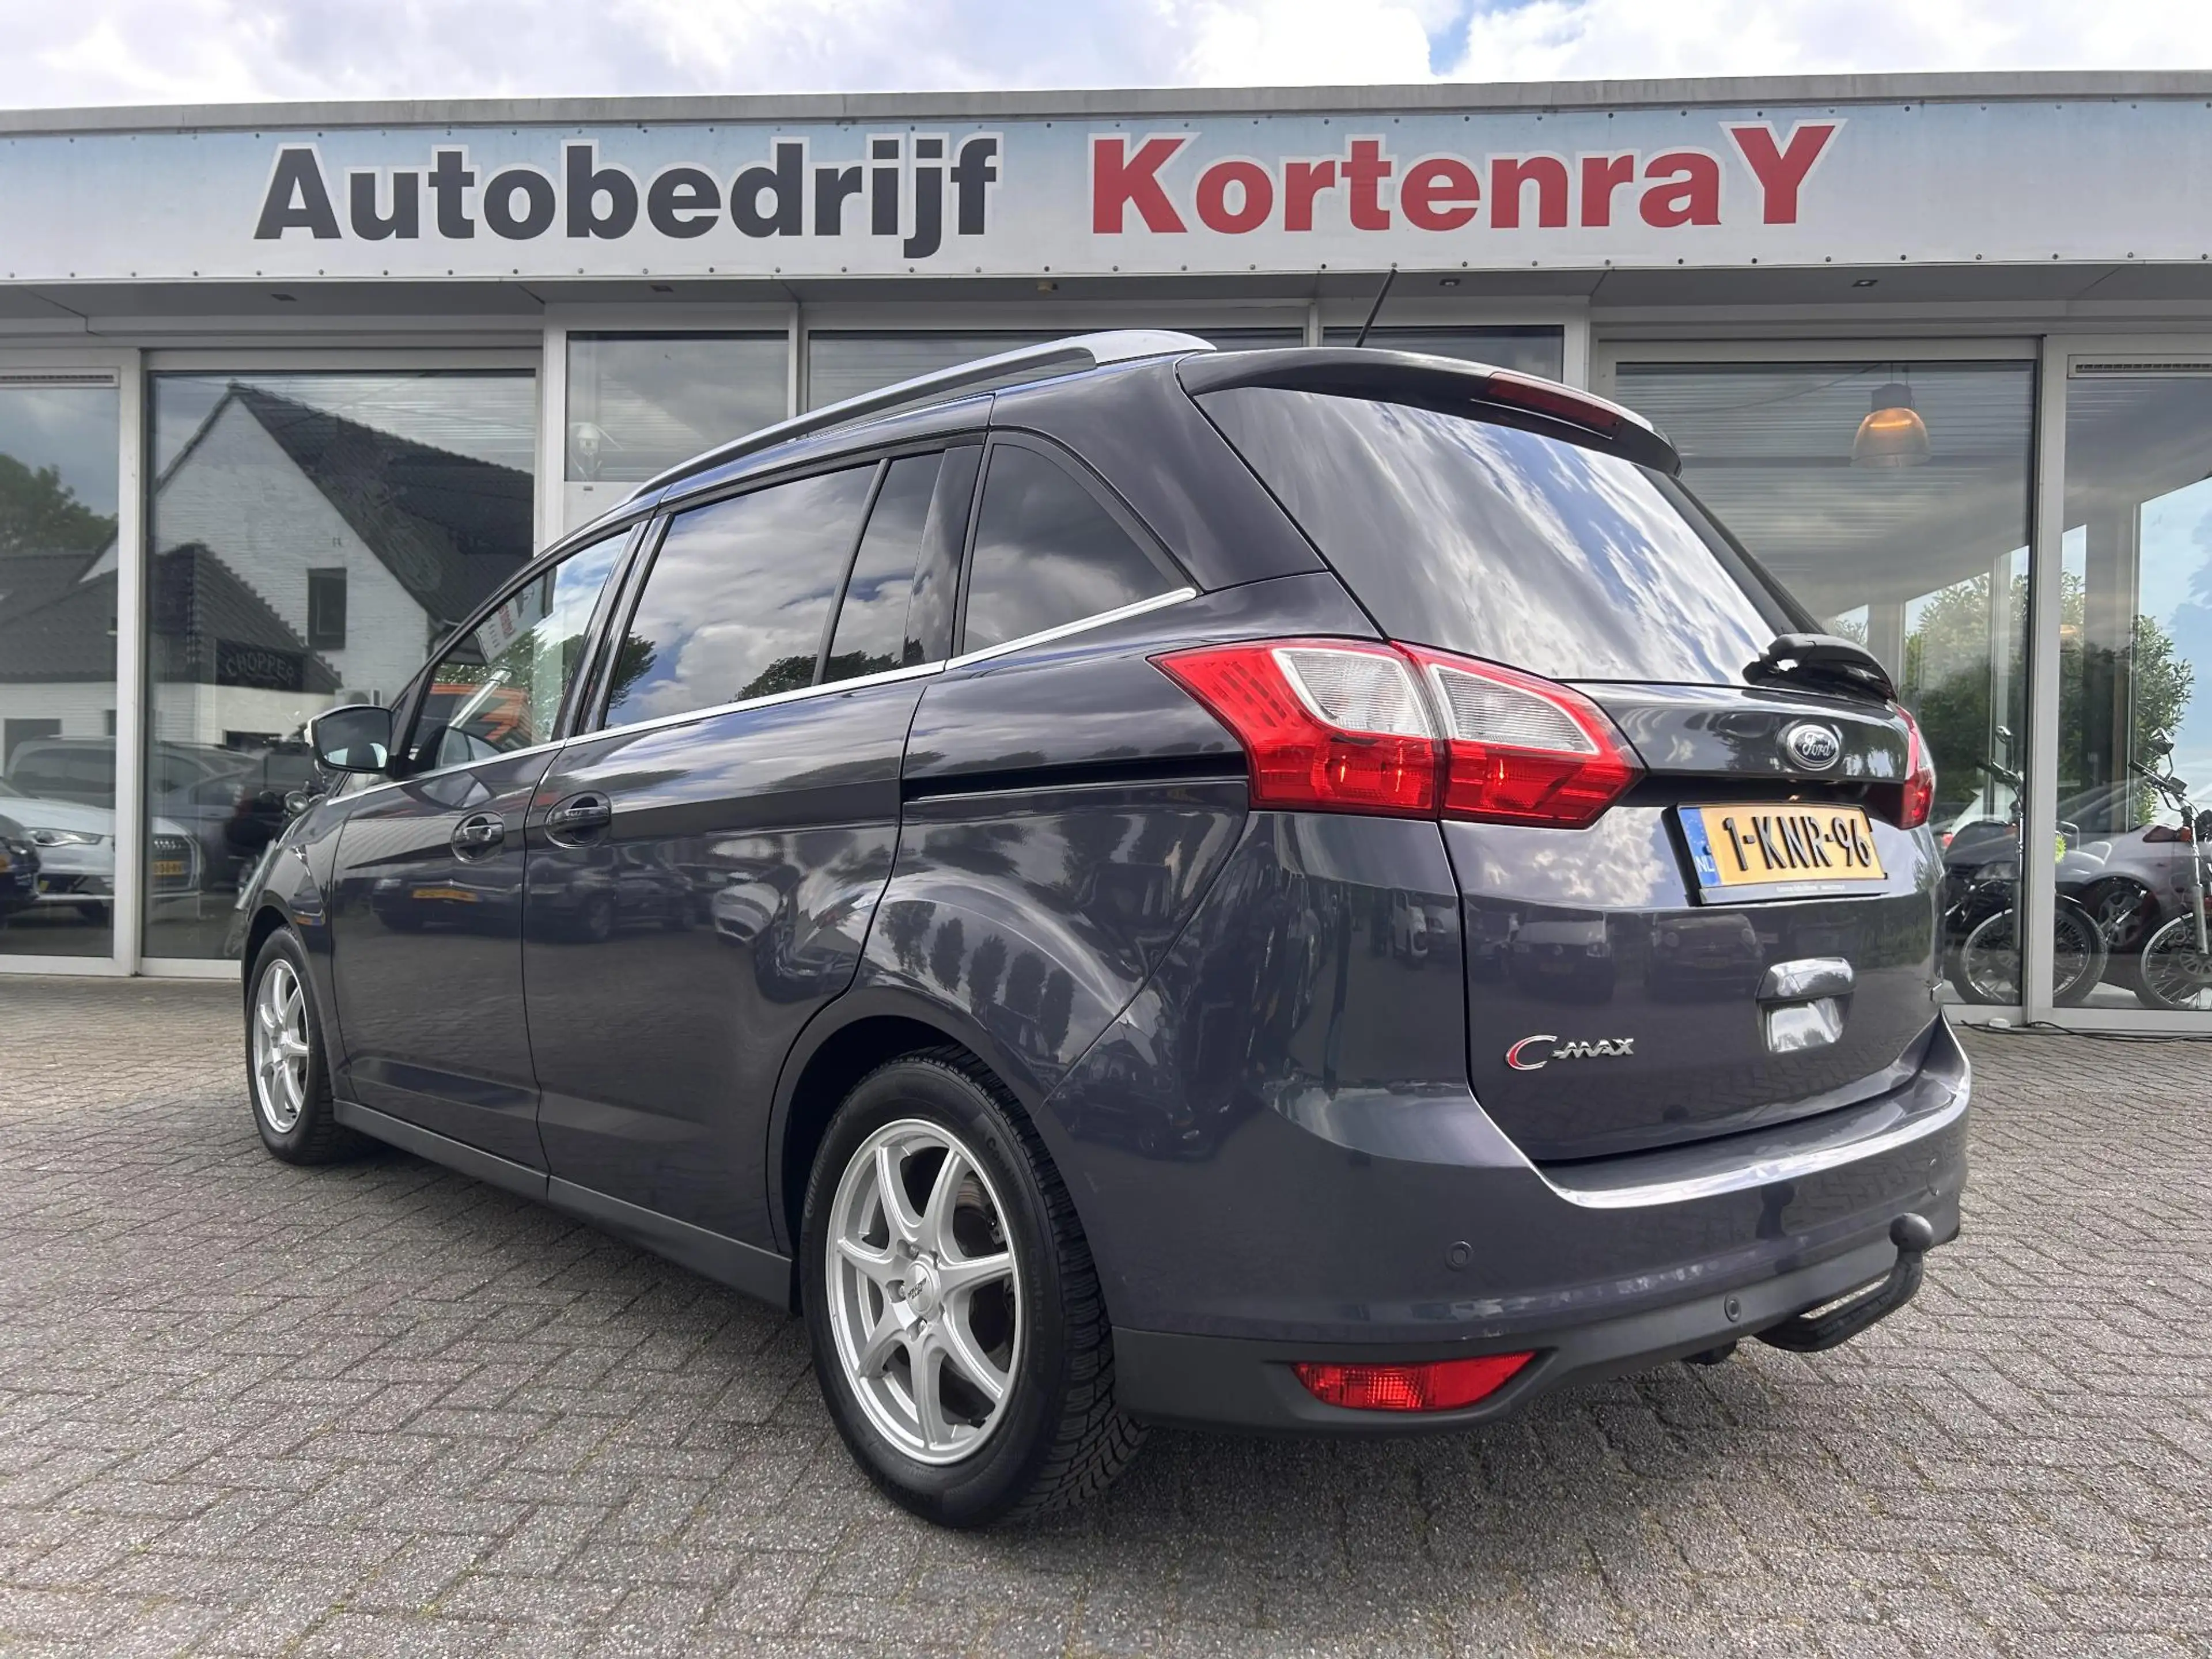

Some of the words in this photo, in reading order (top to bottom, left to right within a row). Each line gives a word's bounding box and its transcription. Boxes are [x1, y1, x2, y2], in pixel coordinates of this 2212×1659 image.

[254, 138, 997, 259] Autobedrijf
[1093, 125, 1835, 234] KortenraY
[1801, 732, 1831, 757] Ford
[1722, 816, 1872, 871] 1-KNR-96
[1695, 855, 1715, 873] NL
[1505, 1034, 1634, 1070] C-MAX
